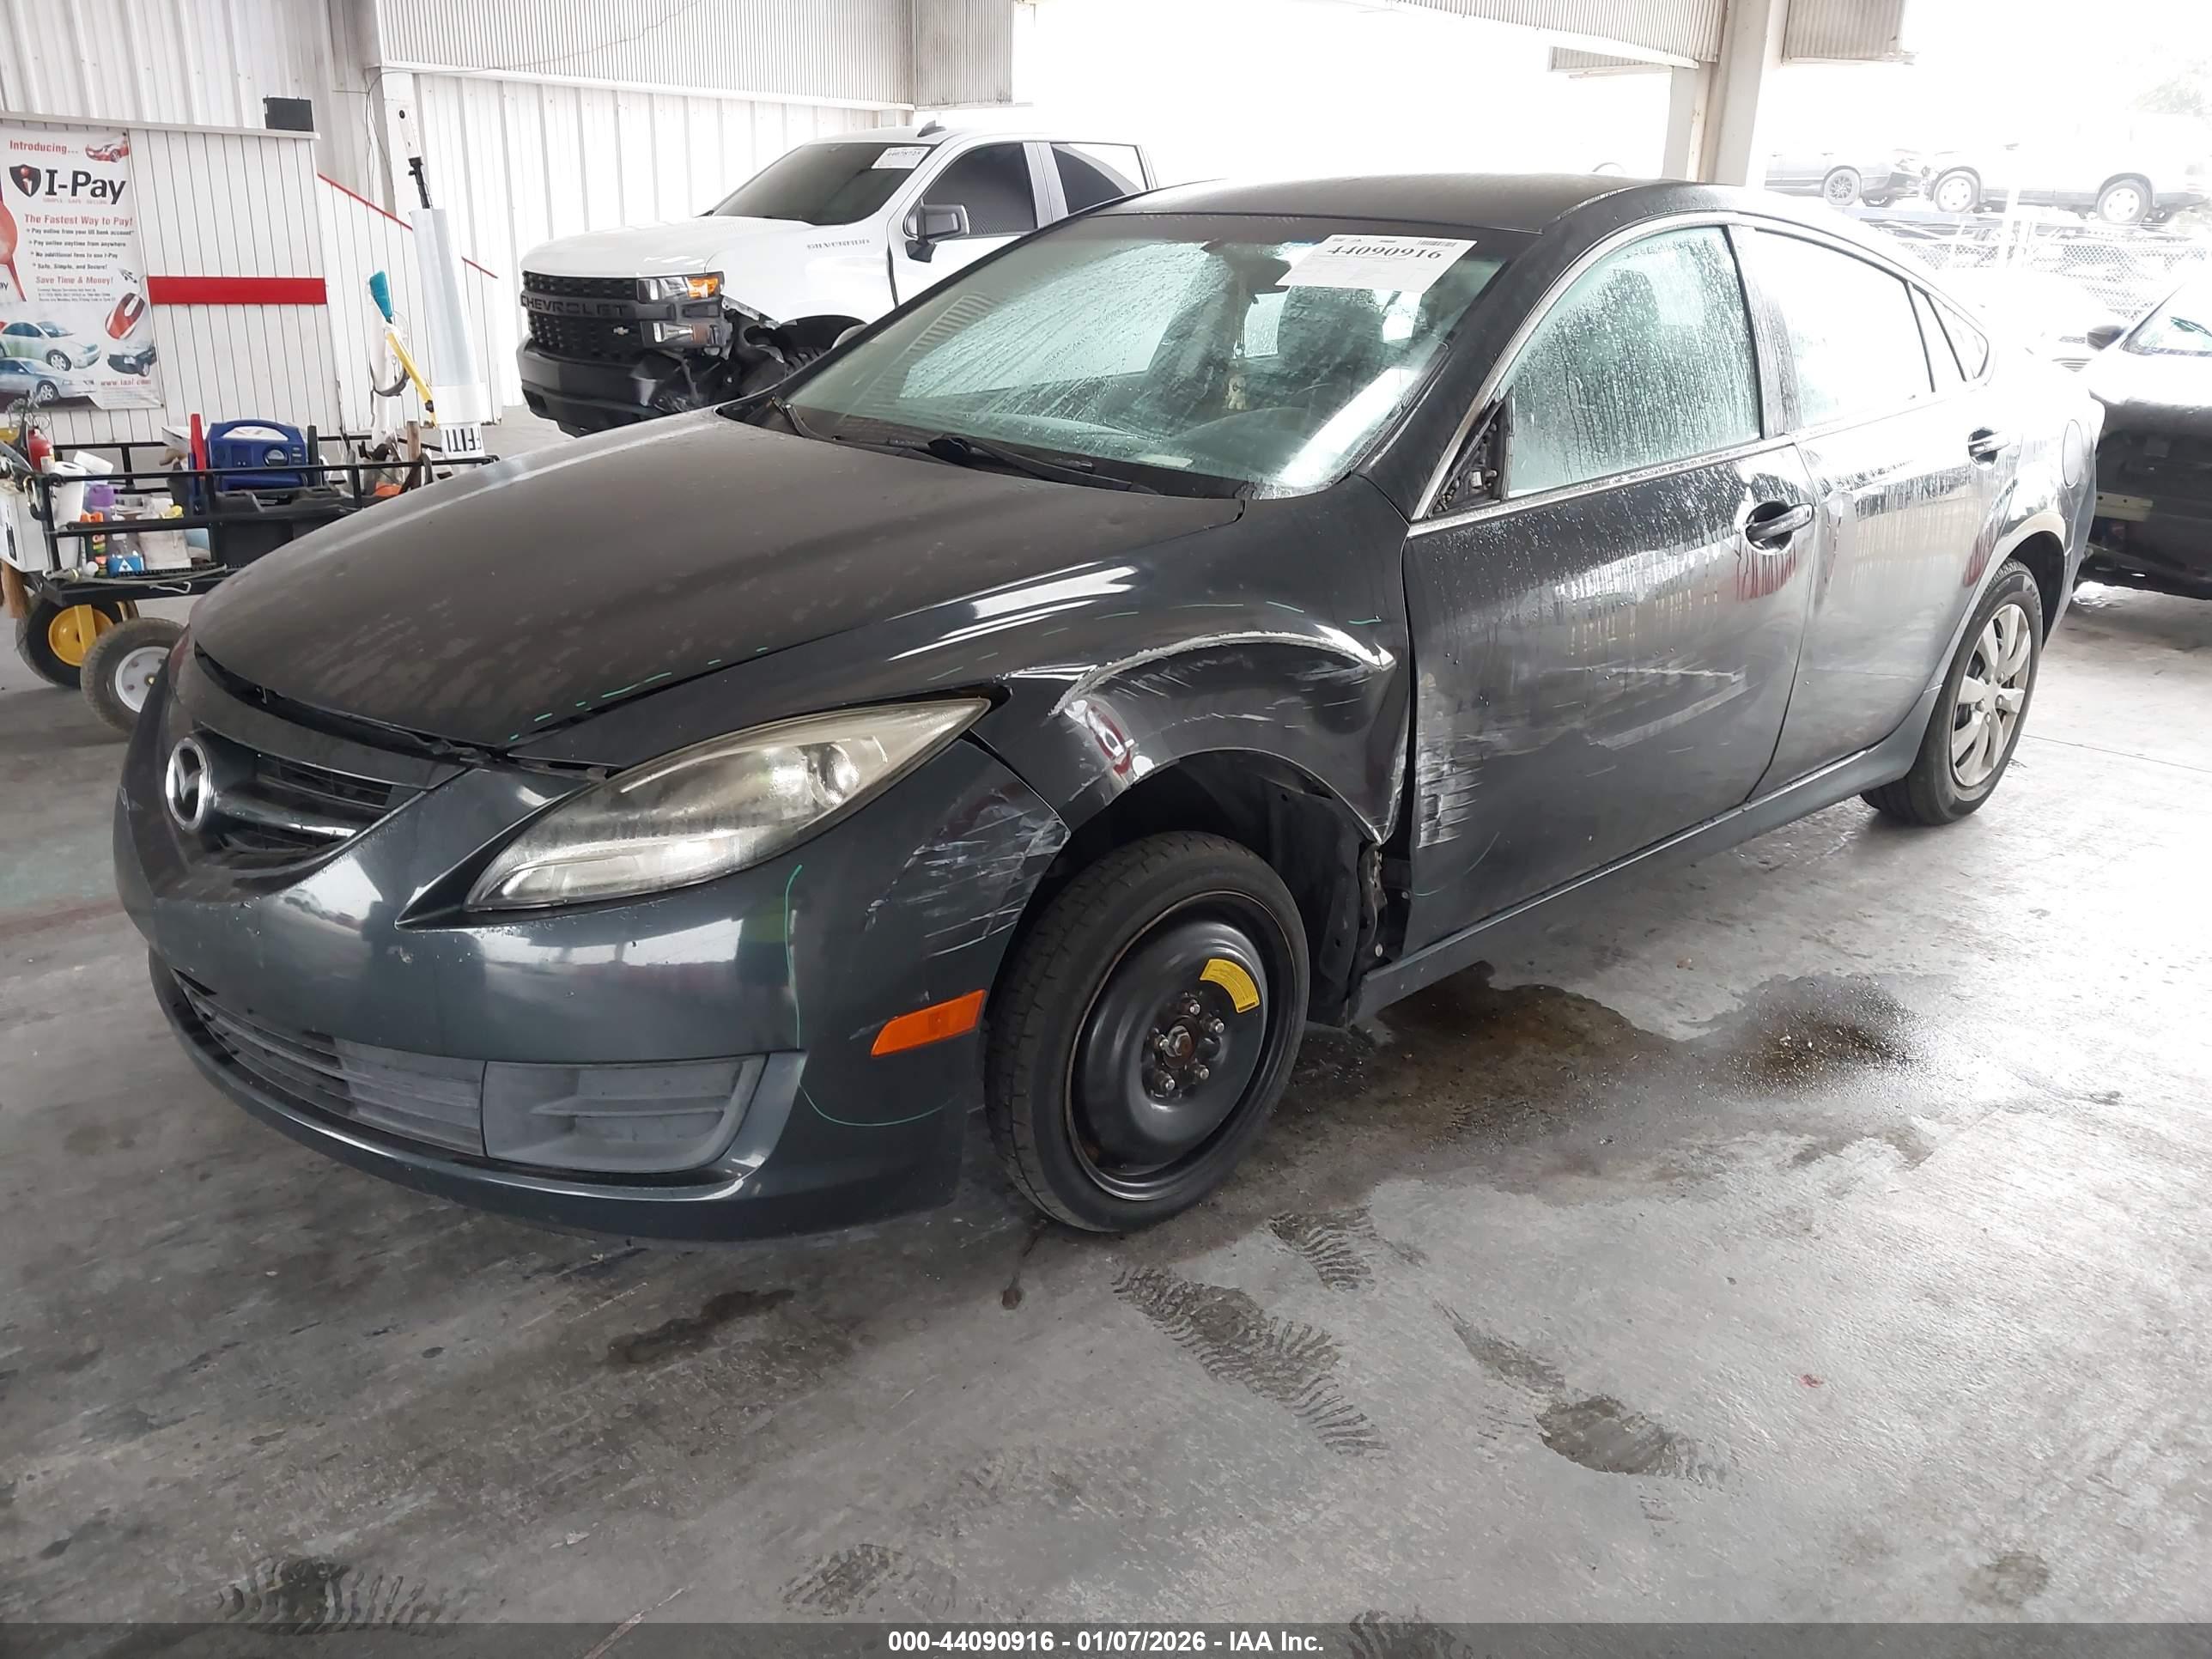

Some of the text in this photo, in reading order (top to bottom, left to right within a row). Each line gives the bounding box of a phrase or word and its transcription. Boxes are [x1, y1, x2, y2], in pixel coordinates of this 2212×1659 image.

[9, 140, 78, 155] Introducing...
[45, 168, 127, 205] I-Pay
[25, 214, 132, 227] The Fastest Way to Pay!
[1327, 246, 1445, 258] 44090916
[58, 276, 75, 284] Time
[86, 276, 113, 286] Money!
[520, 295, 629, 317] CHEVROLET
